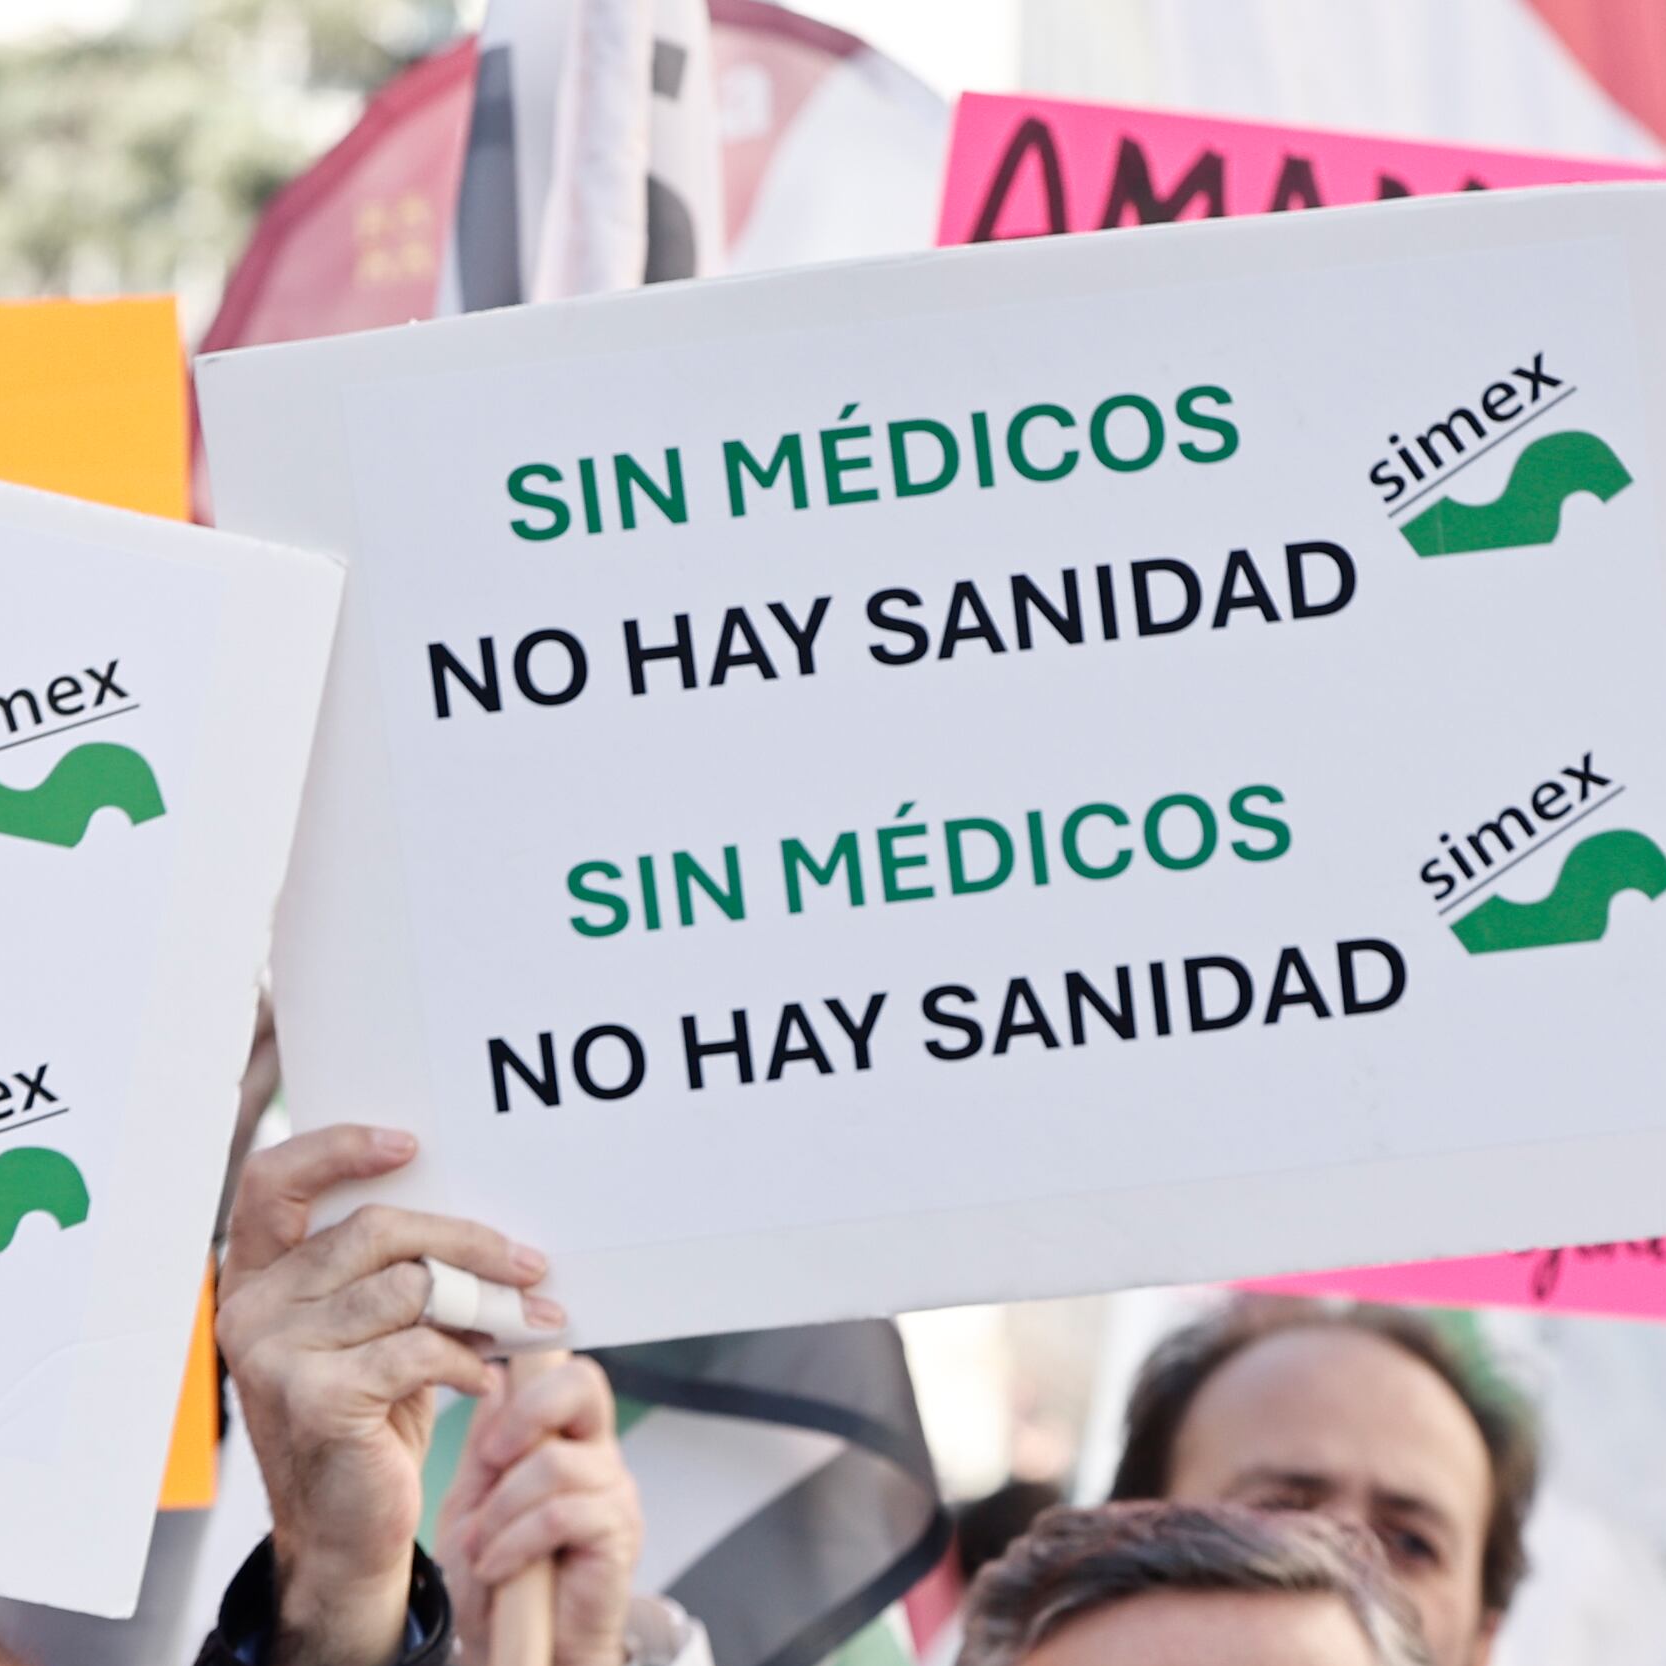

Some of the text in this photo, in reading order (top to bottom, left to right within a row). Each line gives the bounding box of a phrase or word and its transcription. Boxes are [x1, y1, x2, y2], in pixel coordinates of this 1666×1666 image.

[507, 385, 1240, 542] SIN MÉDICOS
[1368, 352, 1562, 503] simex
[428, 541, 1356, 719] NO HAY SANIDAD
[567, 784, 1292, 938] SIN MÉDICOS
[1419, 752, 1611, 902] simex
[488, 939, 1406, 1113] NO HAY SANIDAD
